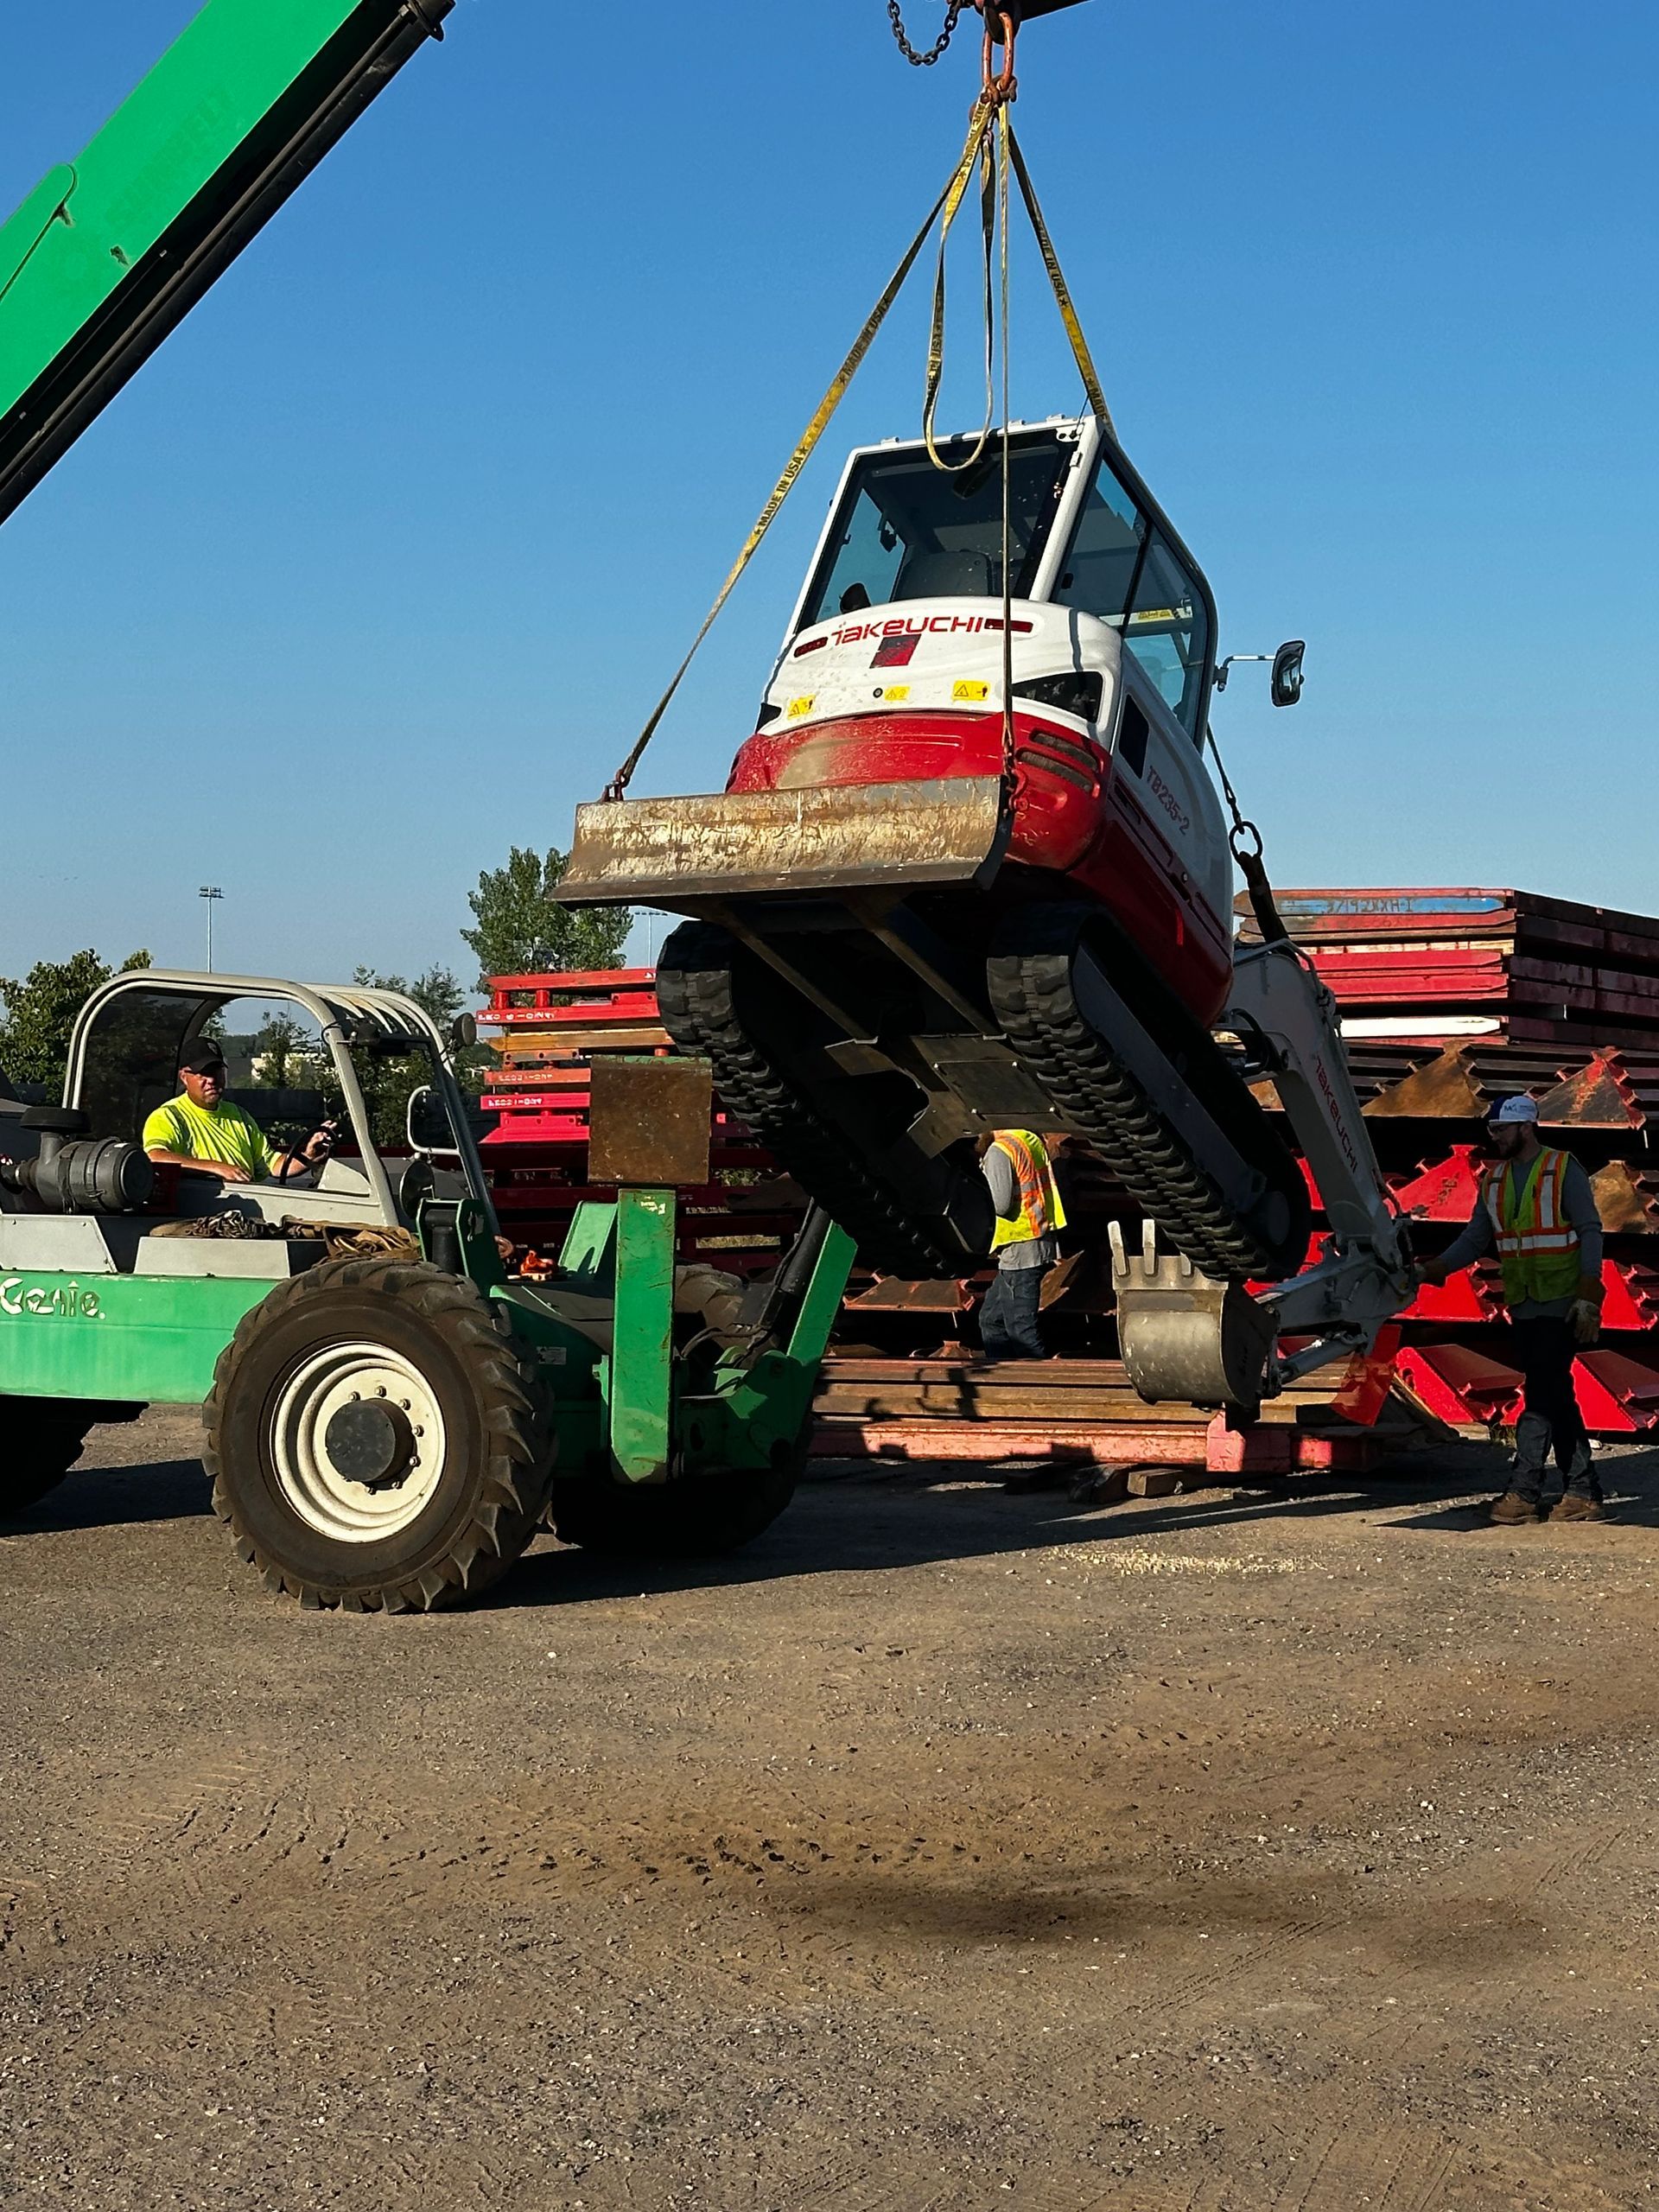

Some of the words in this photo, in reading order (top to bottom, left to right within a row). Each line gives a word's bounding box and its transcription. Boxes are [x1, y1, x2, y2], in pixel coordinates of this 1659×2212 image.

[758, 494, 782, 527] MADE
[776, 480, 790, 493] IN
[784, 456, 804, 478] USA
[831, 616, 983, 646] TAKEUCHI
[1147, 765, 1190, 836] TB235-2
